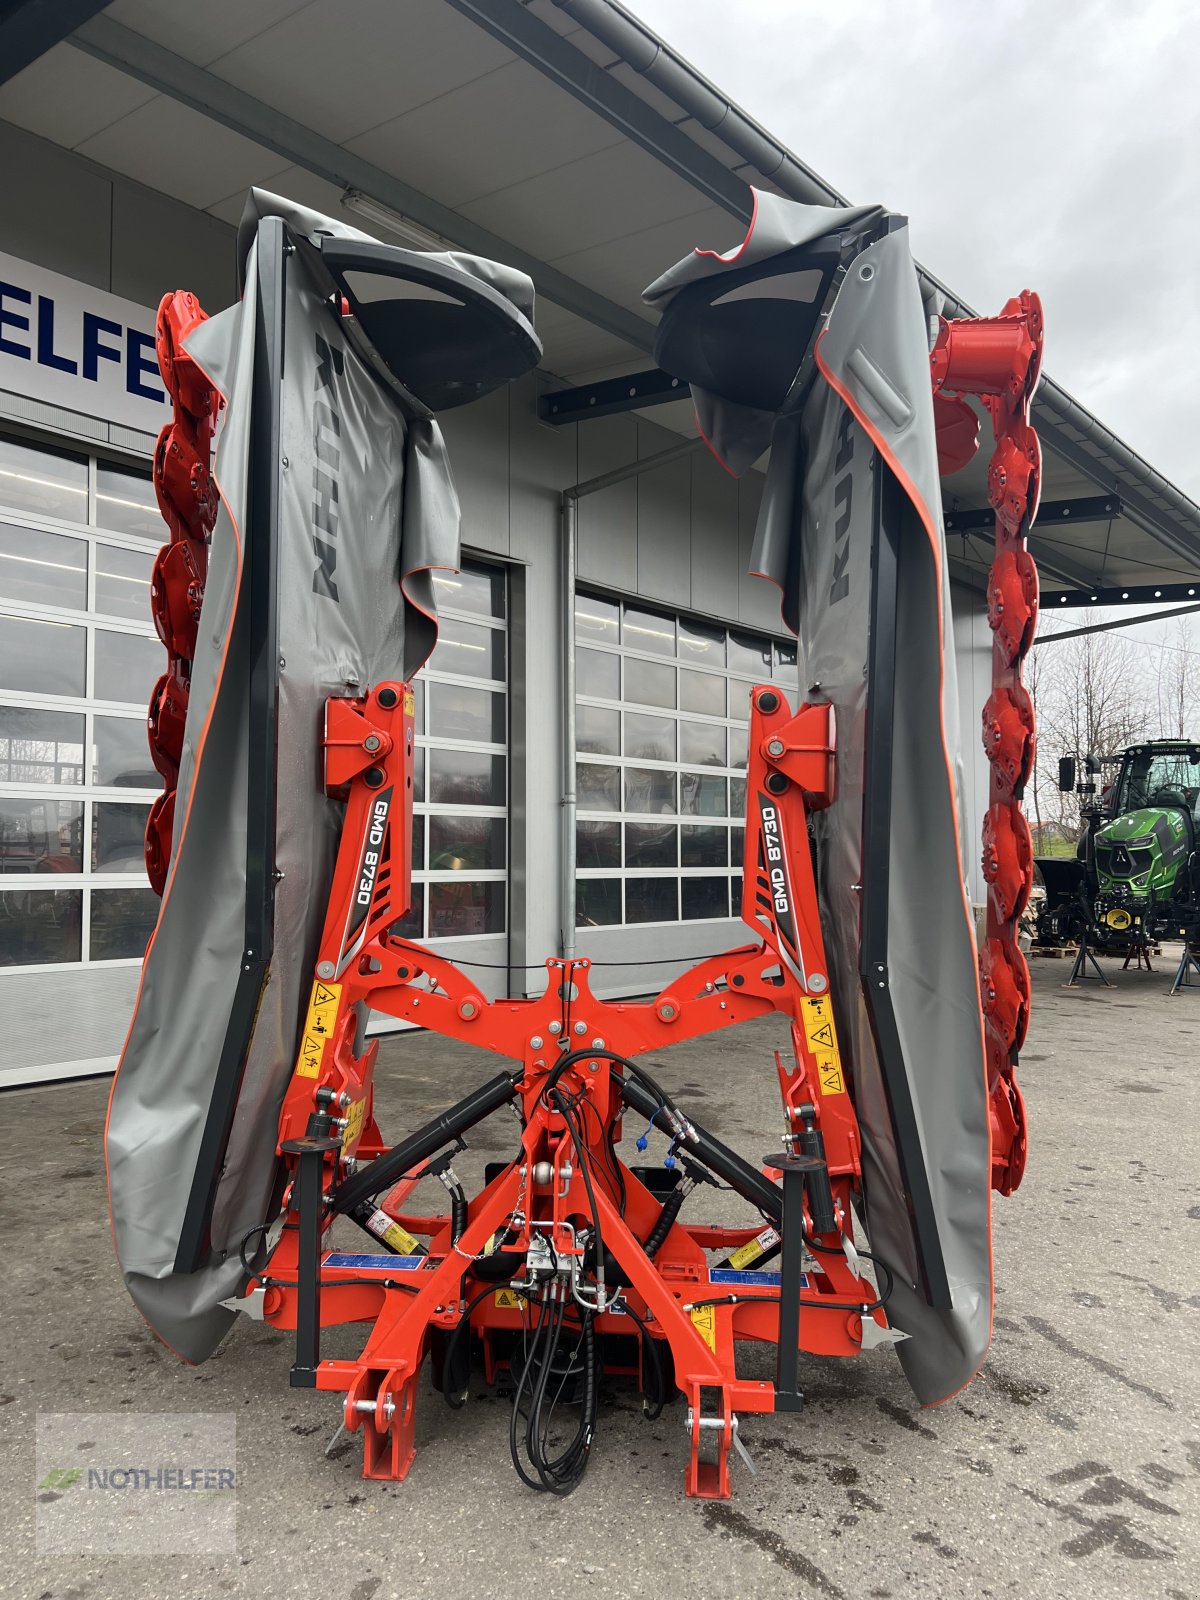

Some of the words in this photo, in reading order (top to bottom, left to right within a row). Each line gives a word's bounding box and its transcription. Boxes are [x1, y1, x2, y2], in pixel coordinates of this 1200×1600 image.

[0, 281, 174, 406] ELFE
[311, 332, 344, 603] KUHN
[369, 800, 389, 845] GMD
[762, 806, 782, 862] 8730
[357, 851, 379, 905] 8730
[771, 868, 789, 914] GMD
